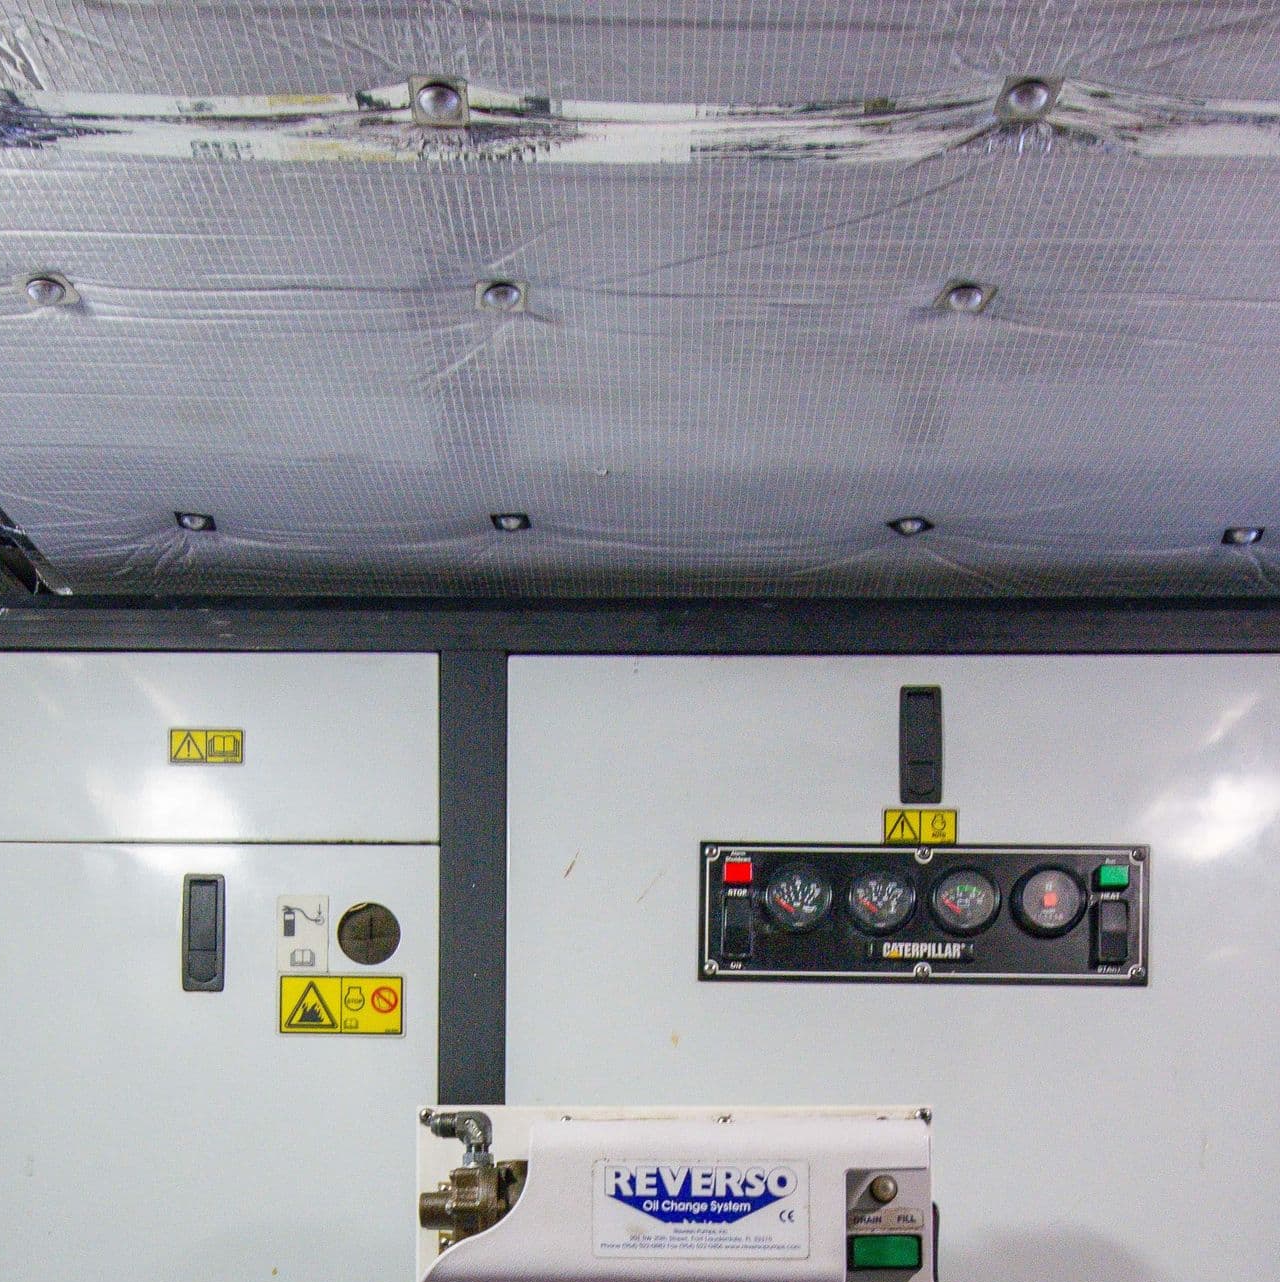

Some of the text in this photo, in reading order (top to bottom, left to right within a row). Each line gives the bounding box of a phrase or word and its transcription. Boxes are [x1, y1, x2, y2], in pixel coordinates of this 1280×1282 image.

[727, 888, 748, 897] STOP
[882, 941, 962, 960] CATERPILLAR
[604, 1165, 799, 1199] REVERSO
[642, 1199, 752, 1214] Oil Change System
[896, 1213, 917, 1224] FILL
